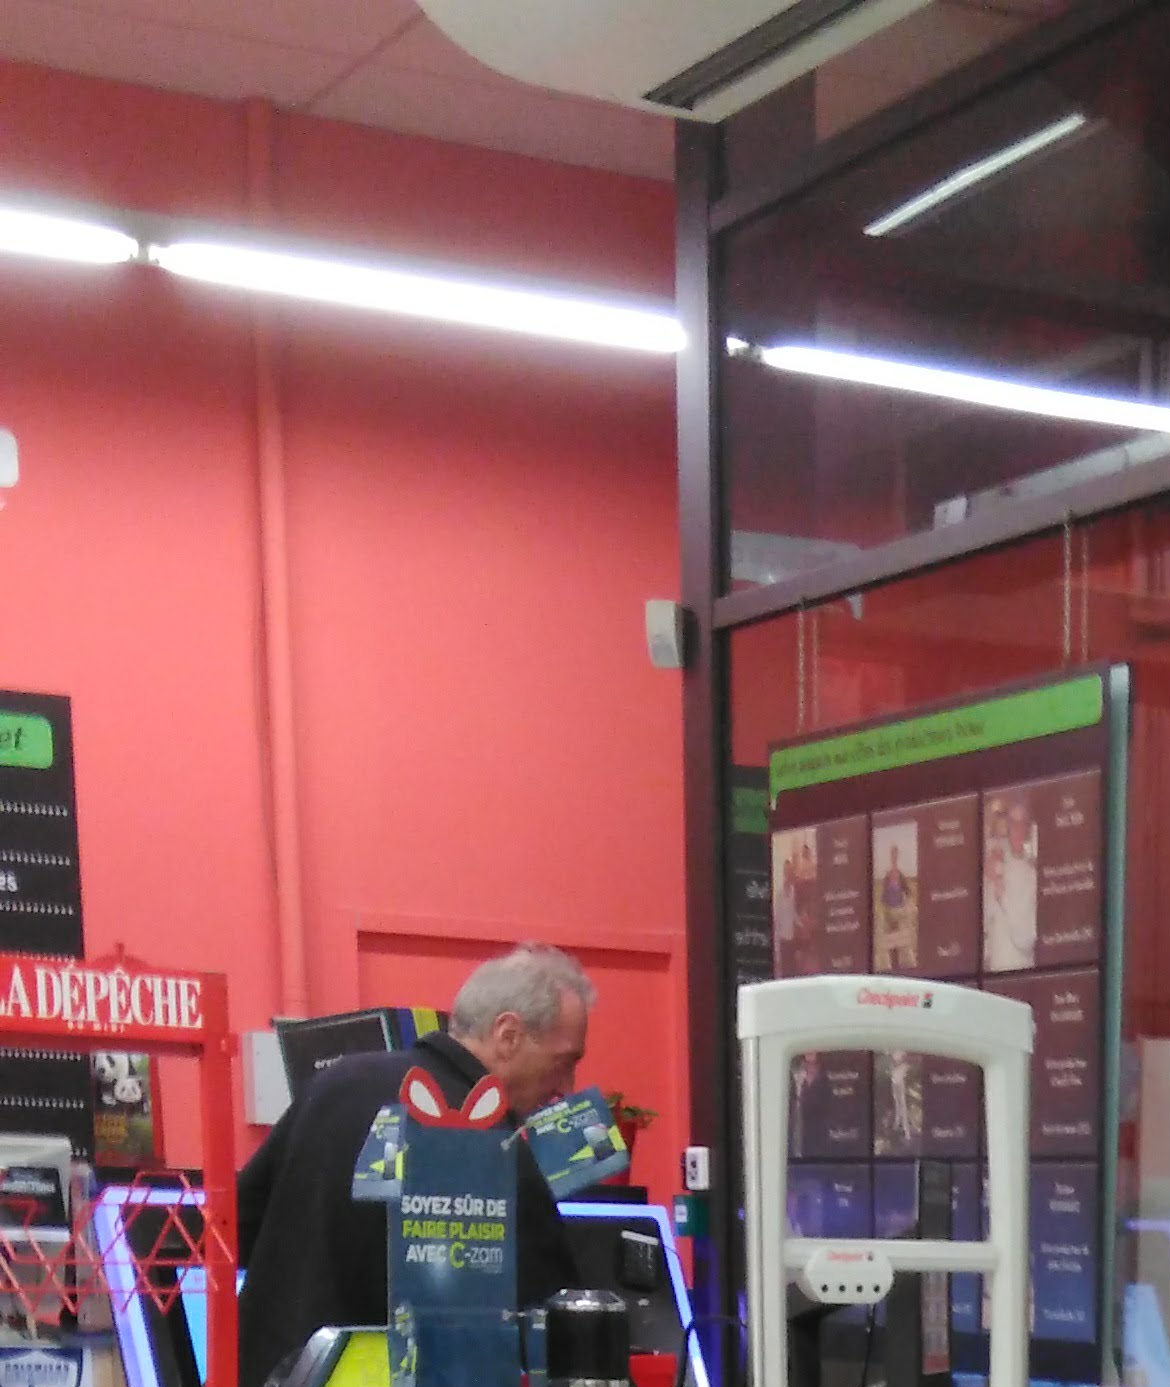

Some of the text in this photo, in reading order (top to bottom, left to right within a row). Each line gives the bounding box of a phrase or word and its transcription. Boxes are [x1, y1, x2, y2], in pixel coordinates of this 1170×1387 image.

[0, 961, 203, 1029] A DÉPÊCHE
[401, 1193, 506, 1217] SOYEZ SÛR DE
[402, 1219, 504, 1241] FAIRE PLAISIR
[406, 1244, 447, 1263] AVEC
